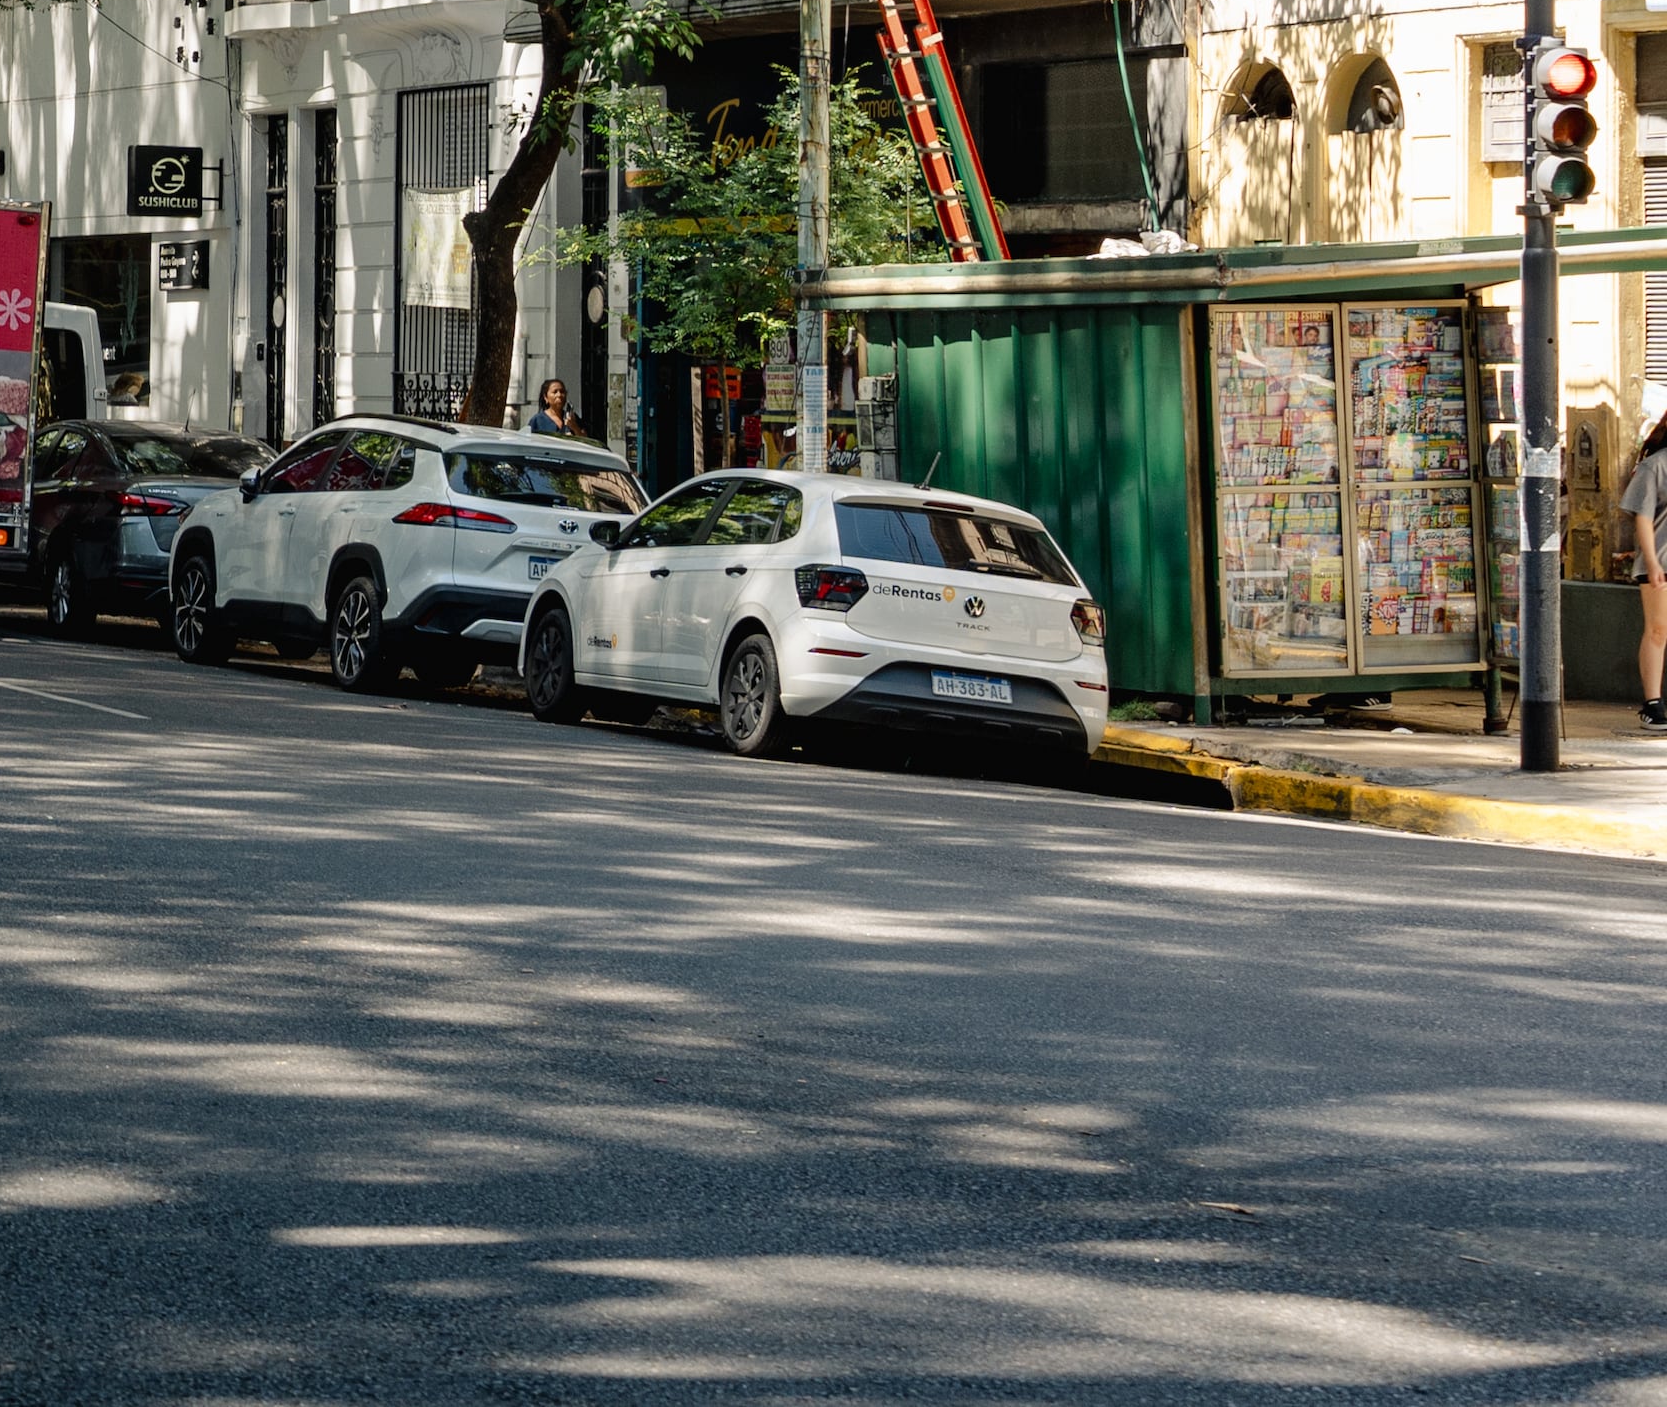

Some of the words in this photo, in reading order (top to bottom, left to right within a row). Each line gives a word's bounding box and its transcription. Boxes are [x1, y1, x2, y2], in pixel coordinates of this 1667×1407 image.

[138, 195, 199, 209] SUSHICLUB
[872, 583, 942, 602] deRentas
[956, 622, 991, 631] TRACK
[937, 678, 955, 692] AH
[959, 680, 985, 697] 383
[990, 685, 1008, 700] AL
